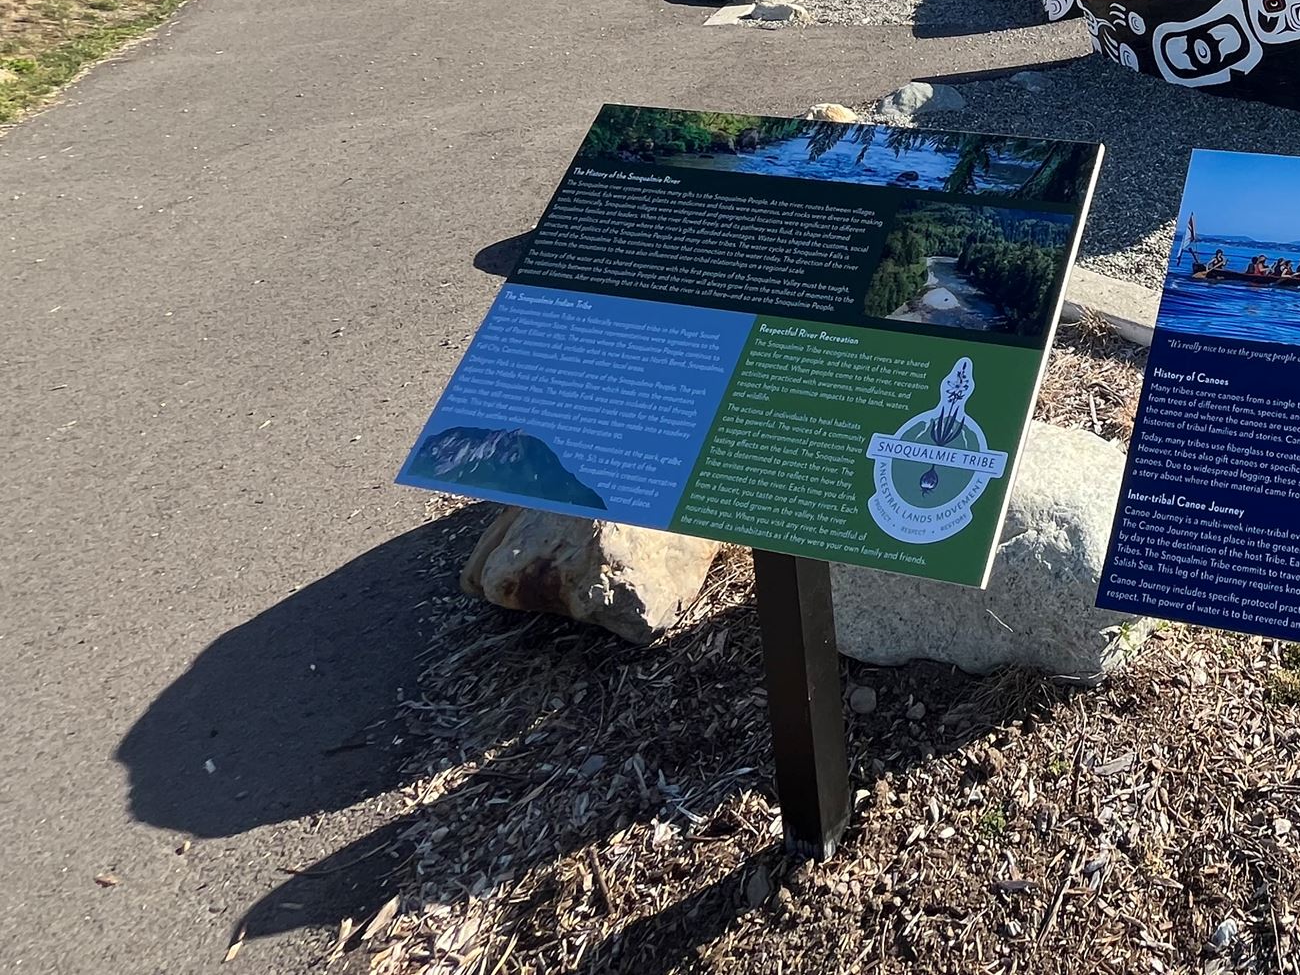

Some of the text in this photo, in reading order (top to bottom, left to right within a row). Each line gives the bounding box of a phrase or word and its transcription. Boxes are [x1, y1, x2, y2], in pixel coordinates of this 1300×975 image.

[573, 167, 680, 184] The History of the Snoqualmie River
[759, 323, 858, 344] Respectful River Recreation
[754, 338, 766, 346] The
[767, 340, 804, 351] Snoqualmie
[806, 345, 821, 354] Tribe
[822, 349, 857, 358] recognizes
[859, 352, 873, 361] that
[906, 359, 930, 368] shared
[1153, 367, 1228, 385] History of Canoes
[877, 441, 995, 468] SNOQUALMIE TRIBE
[880, 462, 983, 523] ANCESTRAL LANDS MOVEMENT
[1139, 469, 1158, 480] story
[1160, 471, 1182, 482] about
[1184, 475, 1208, 485] where
[1210, 478, 1229, 488] their
[1230, 483, 1263, 493] material
[1264, 488, 1286, 496] came
[1127, 489, 1244, 518] Inter-tribal Canoe Journey
[680, 514, 692, 523] the
[709, 521, 725, 529] and
[734, 524, 772, 537] inhabitants
[789, 533, 806, 544] they
[860, 545, 882, 558] family
